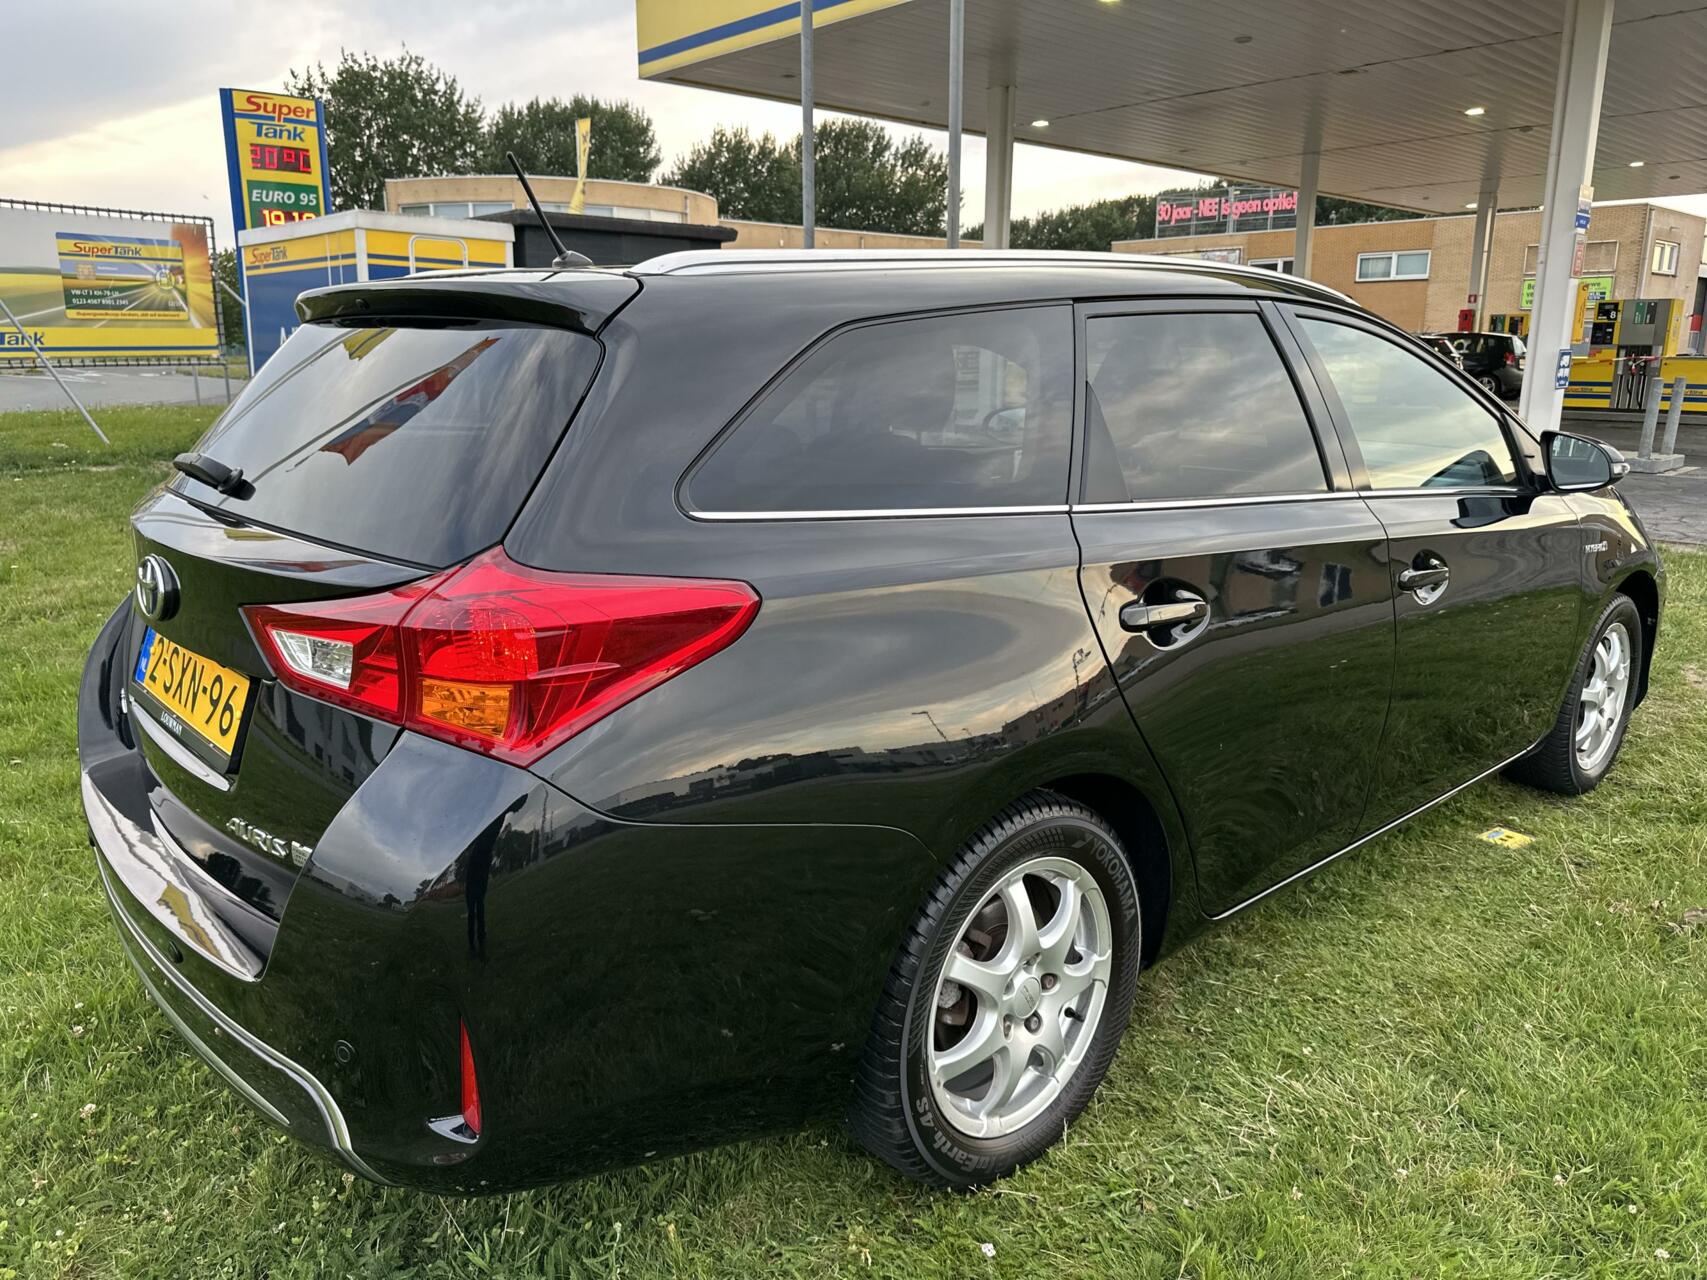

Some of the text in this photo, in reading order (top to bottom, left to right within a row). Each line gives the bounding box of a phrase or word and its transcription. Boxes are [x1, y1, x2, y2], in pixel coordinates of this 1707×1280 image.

[234, 95, 314, 122] Super
[248, 121, 304, 142] Tank
[251, 189, 317, 206] EURO 95
[1170, 203, 1192, 225] jaar
[1232, 200, 1261, 219] geen
[69, 242, 142, 258] SuperTank
[249, 246, 287, 268] SuperTank
[1609, 311, 1617, 319] 8
[149, 637, 238, 737] 2-SXN-96
[226, 817, 288, 858] AURIS
[1090, 837, 1136, 923] YOKOHAMA
